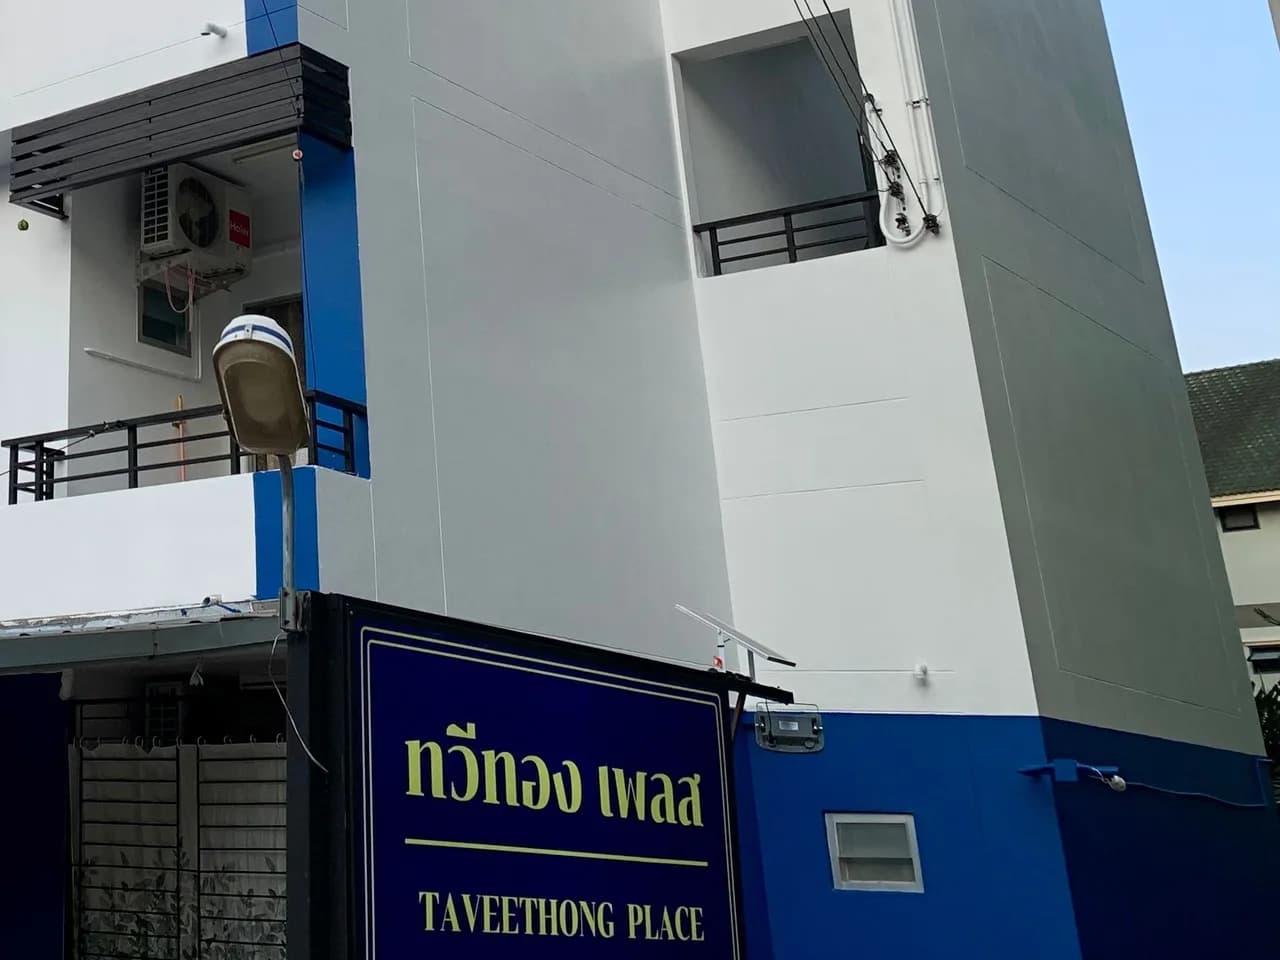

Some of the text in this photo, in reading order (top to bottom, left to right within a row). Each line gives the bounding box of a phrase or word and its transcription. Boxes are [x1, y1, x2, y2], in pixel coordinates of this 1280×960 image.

[404, 722, 705, 828] ทวีทอง เพลส
[418, 890, 706, 941] TAVEETHONG PLACE
